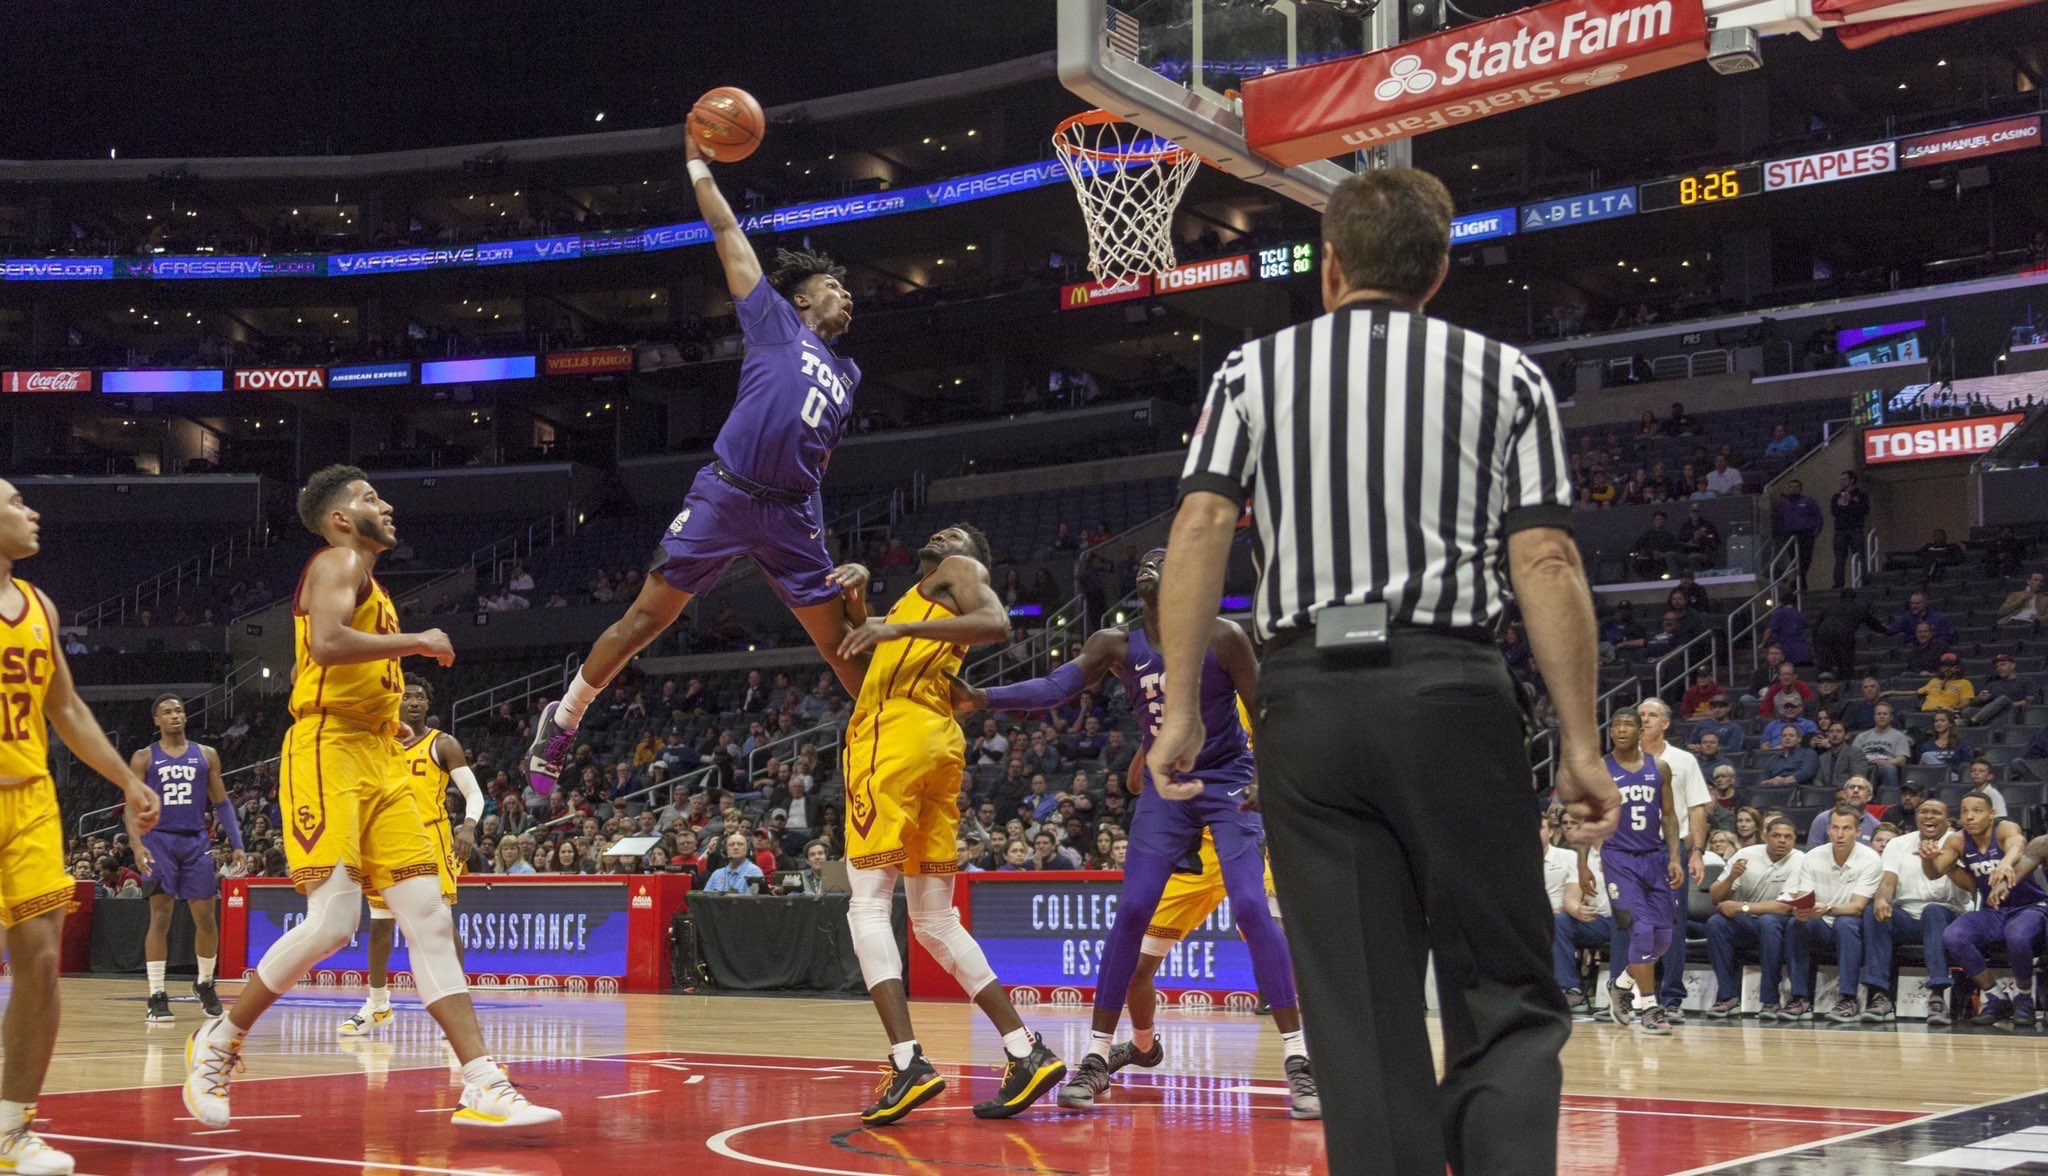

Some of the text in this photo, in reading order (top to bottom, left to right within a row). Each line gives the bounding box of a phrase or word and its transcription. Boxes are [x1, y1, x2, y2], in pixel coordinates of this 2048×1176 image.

[1917, 126, 2036, 157] SAN MANUEL CASINO
[1768, 145, 1890, 188] STAPLES
[1680, 170, 1739, 205] 8:26
[1551, 194, 1632, 222] DELTA
[1455, 218, 1498, 237] LIGHT
[1259, 248, 1287, 264] TCU
[1157, 258, 1248, 290] TOSHIBA
[1260, 262, 1288, 278] USC
[549, 353, 631, 368] WELLS FARGO
[236, 371, 323, 388] TOYOTA
[332, 371, 407, 381] AMERICAN EXPRESS
[801, 351, 845, 405] TCU
[0, 692, 31, 740] 12
[158, 765, 196, 782] TCU
[163, 783, 192, 805] 22
[1619, 785, 1655, 804] TCU
[1631, 806, 1647, 830] 5
[1033, 895, 1117, 930] COLLEG
[459, 913, 587, 950] ASSISTANCE
